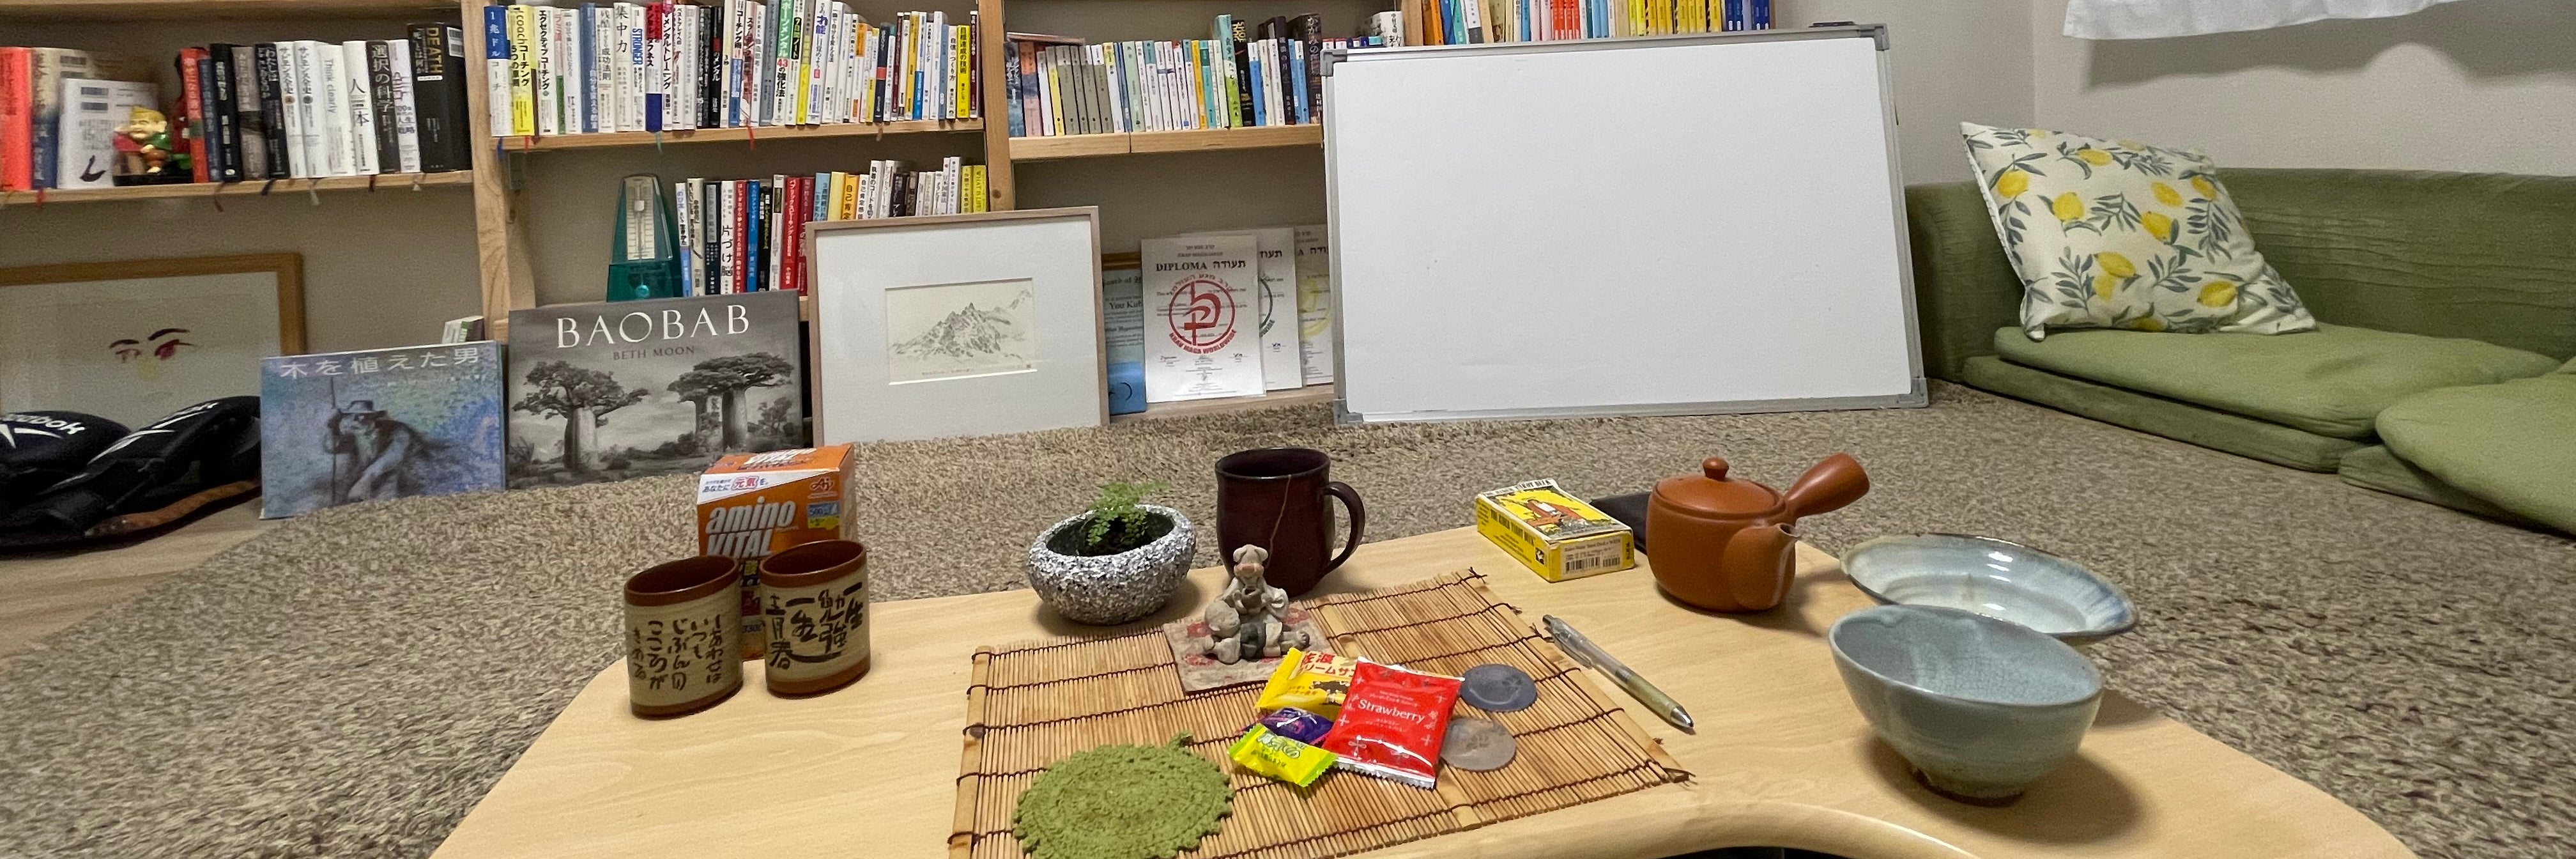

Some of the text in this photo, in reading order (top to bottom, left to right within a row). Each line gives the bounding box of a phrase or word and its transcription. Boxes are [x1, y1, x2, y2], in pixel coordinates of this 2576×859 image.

[427, 27, 443, 75] DEATH
[615, 5, 629, 53] 集中力
[632, 28, 643, 66] STRONGER
[279, 47, 295, 94] サピエンス全史
[297, 47, 312, 94] サピエンス全史
[663, 19, 671, 89] メンタルトレーニング
[325, 59, 339, 115] Think clearly
[371, 44, 395, 112] 選択の科学
[721, 225, 733, 277] 片づけ脳
[1156, 261, 1208, 272] DIPLOMA
[1213, 259, 1247, 269] תעודה
[556, 304, 750, 348] BAOBAB
[280, 346, 480, 379] 木を植えた男
[612, 344, 695, 361] BETH MOON
[705, 496, 796, 534] amino
[707, 529, 774, 559] VITAL
[1358, 699, 1426, 725] Strawberry
